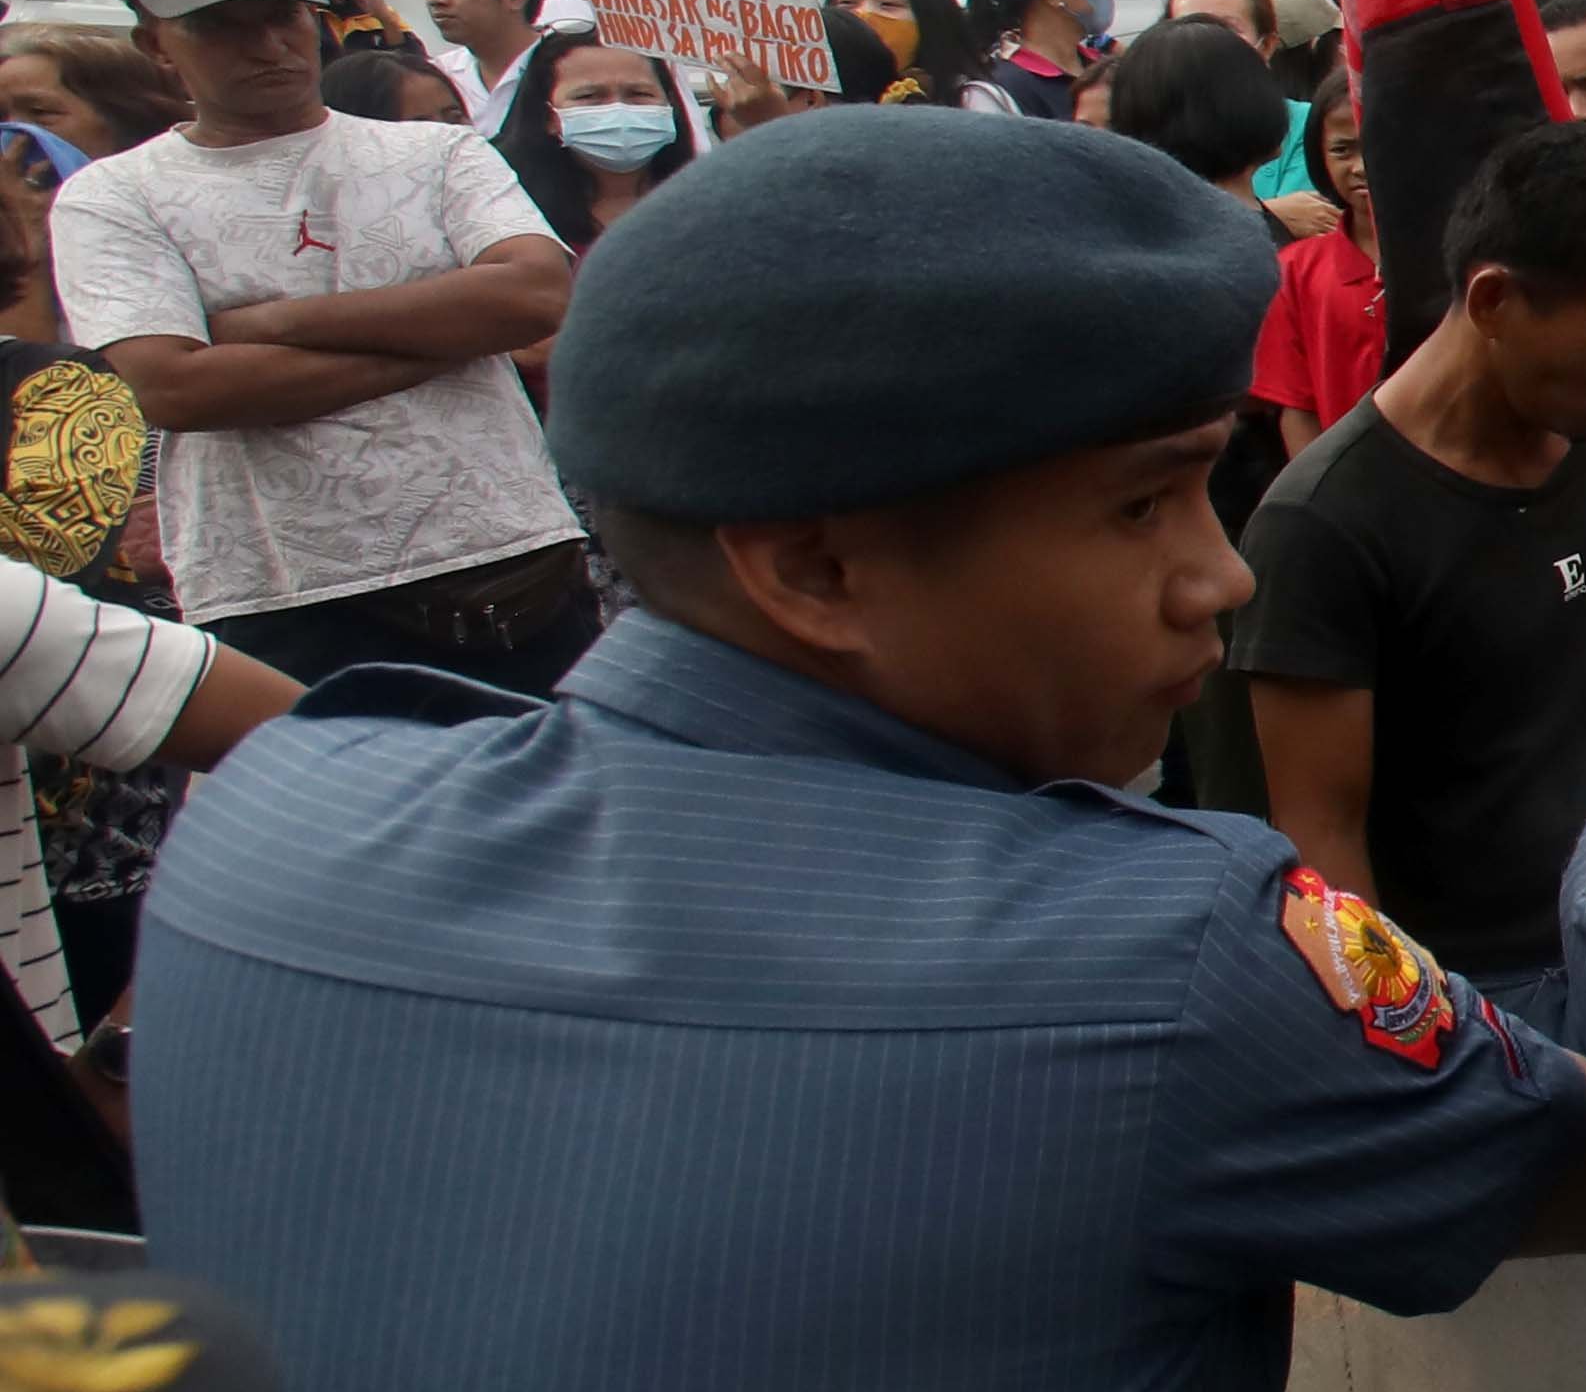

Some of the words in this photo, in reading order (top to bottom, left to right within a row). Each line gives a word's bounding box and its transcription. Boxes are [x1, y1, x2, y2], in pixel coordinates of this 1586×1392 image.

[596, 11, 665, 52] HINDI
[668, 23, 697, 57] SA
[740, 0, 823, 43] BAGYO
